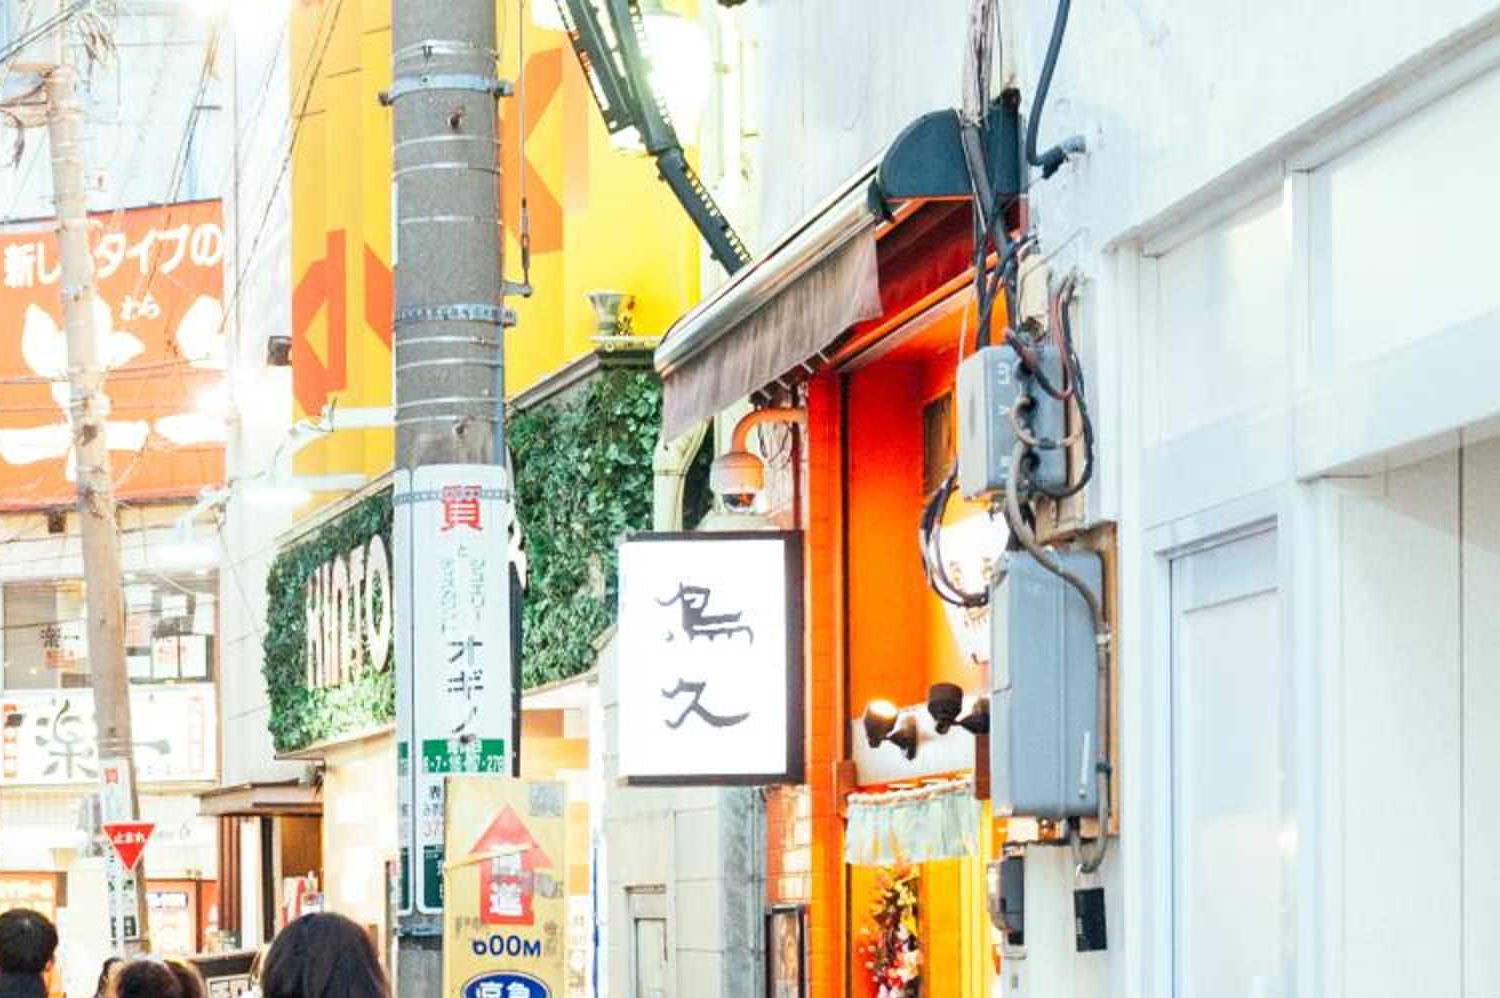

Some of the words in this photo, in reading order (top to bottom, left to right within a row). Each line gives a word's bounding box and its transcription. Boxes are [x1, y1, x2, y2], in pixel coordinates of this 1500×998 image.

[4, 222, 223, 288] 新しタイプの
[113, 831, 145, 845] 止まれ
